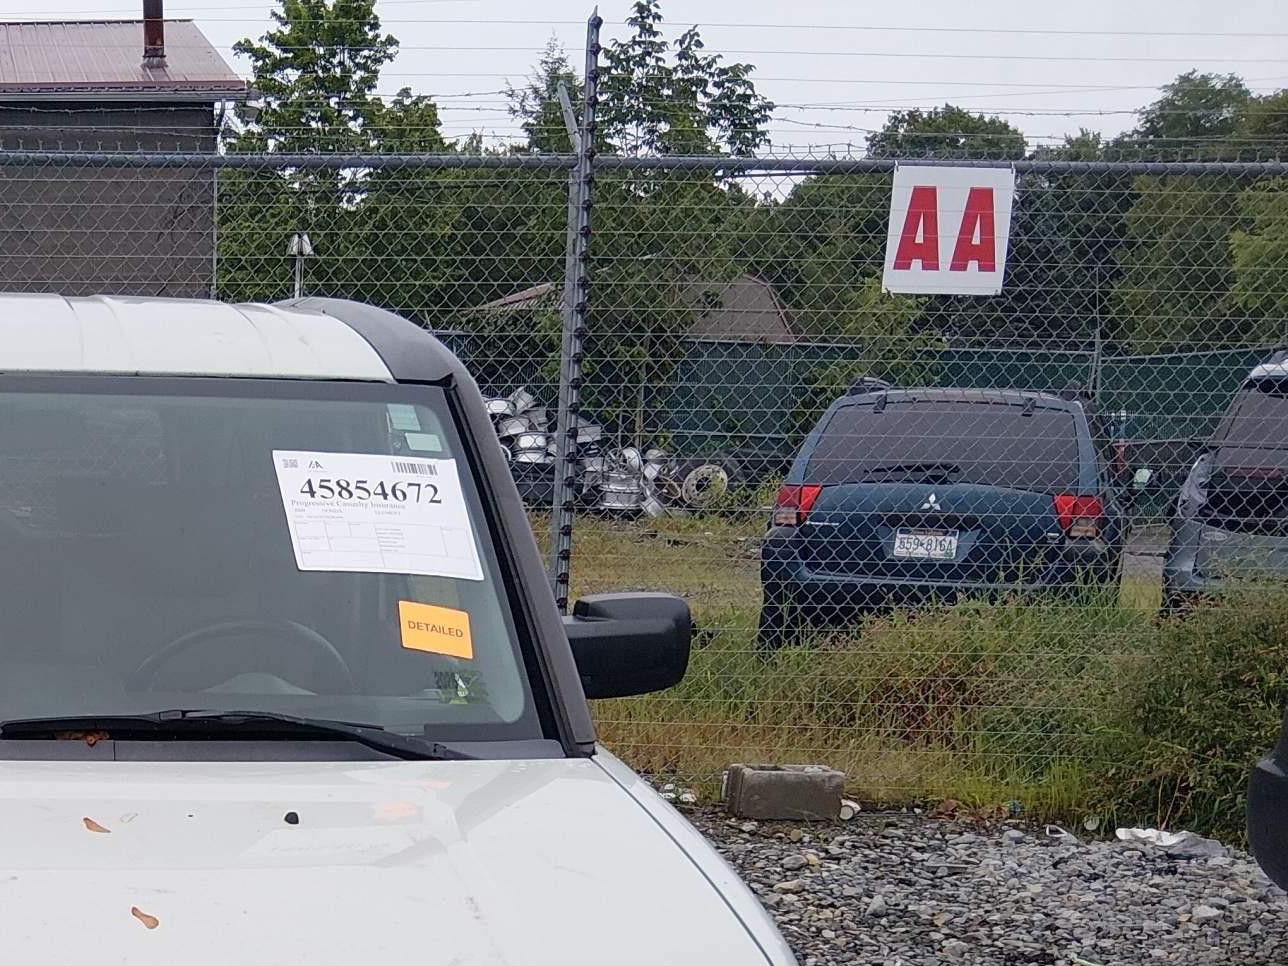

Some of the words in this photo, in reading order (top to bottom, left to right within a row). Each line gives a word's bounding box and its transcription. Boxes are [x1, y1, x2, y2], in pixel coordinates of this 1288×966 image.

[893, 185, 996, 272] AA
[300, 478, 442, 504] 45854672
[408, 620, 464, 638] DETAILED
